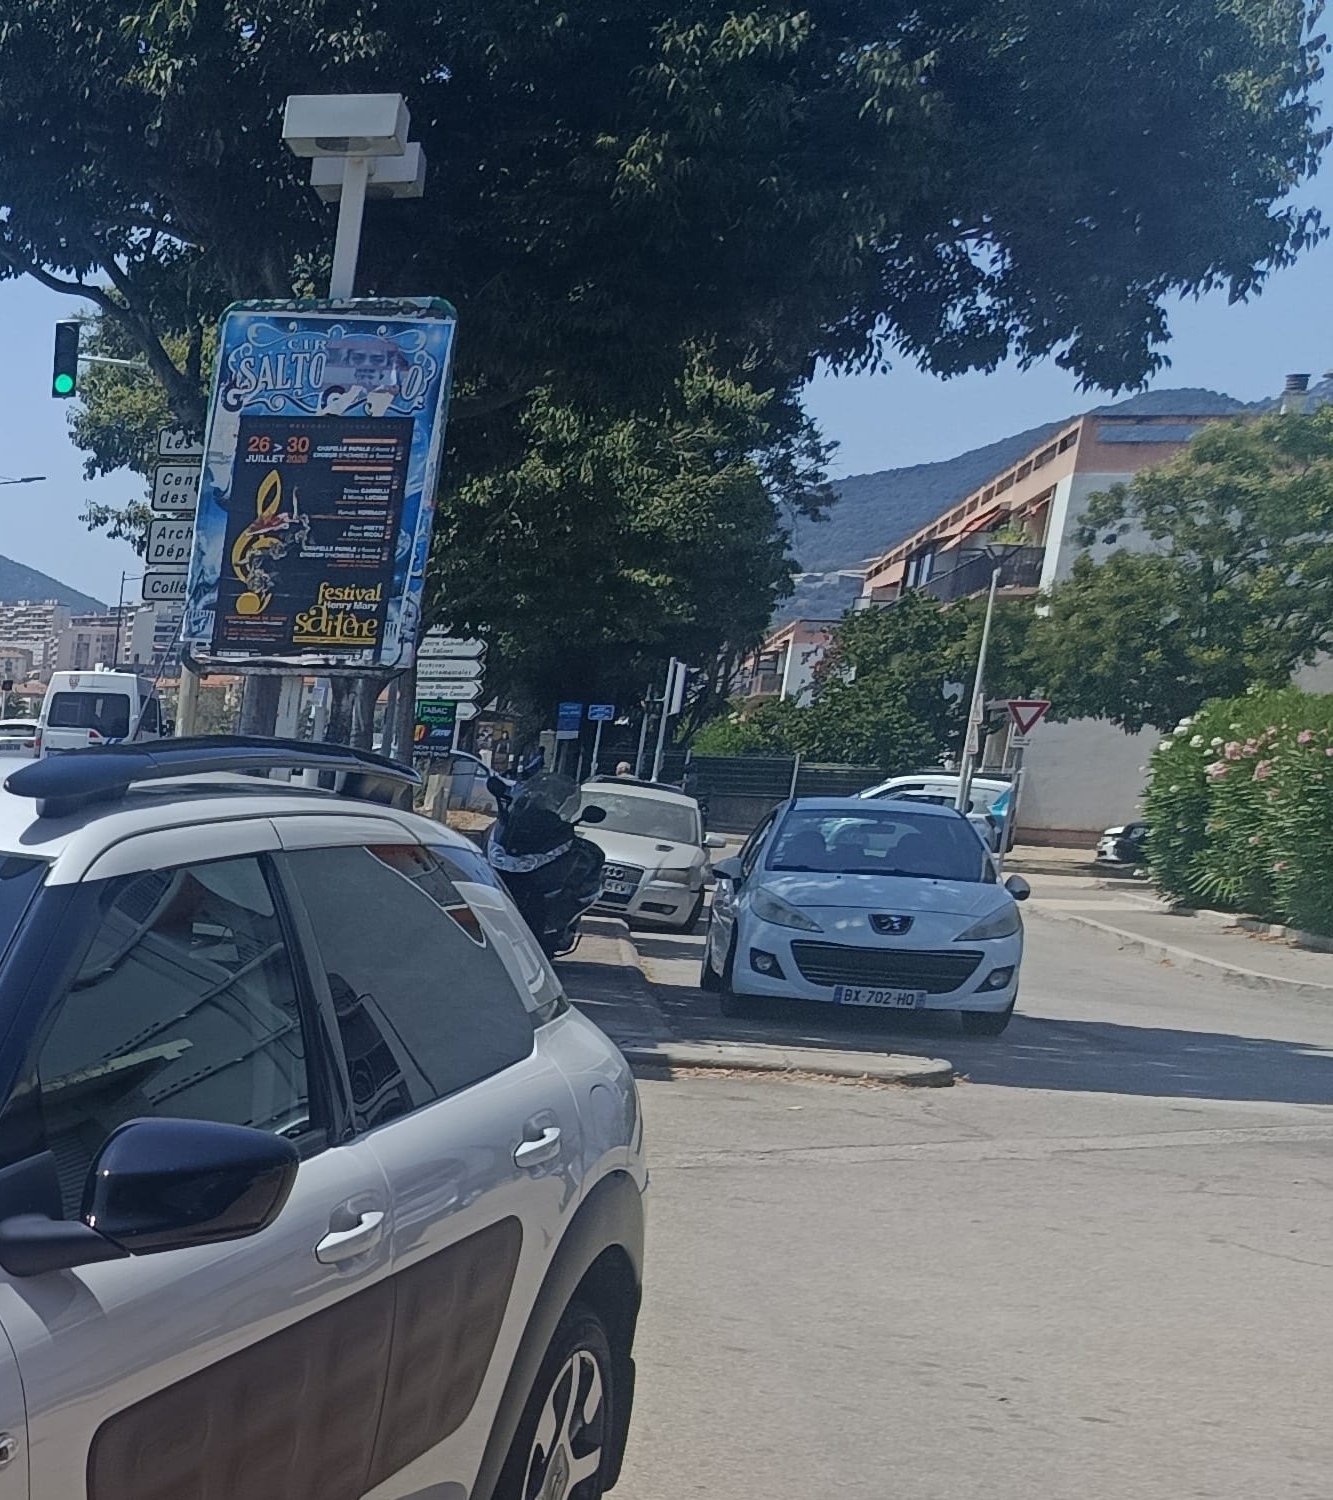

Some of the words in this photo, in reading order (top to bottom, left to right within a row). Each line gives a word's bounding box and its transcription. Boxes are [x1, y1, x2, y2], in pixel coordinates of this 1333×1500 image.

[247, 436, 271, 453] 26
[286, 436, 310, 453] 30
[245, 454, 285, 463] JUILLET
[162, 472, 197, 486] Cen
[160, 491, 188, 504] des
[318, 582, 383, 604] festival
[324, 600, 352, 610] Henry
